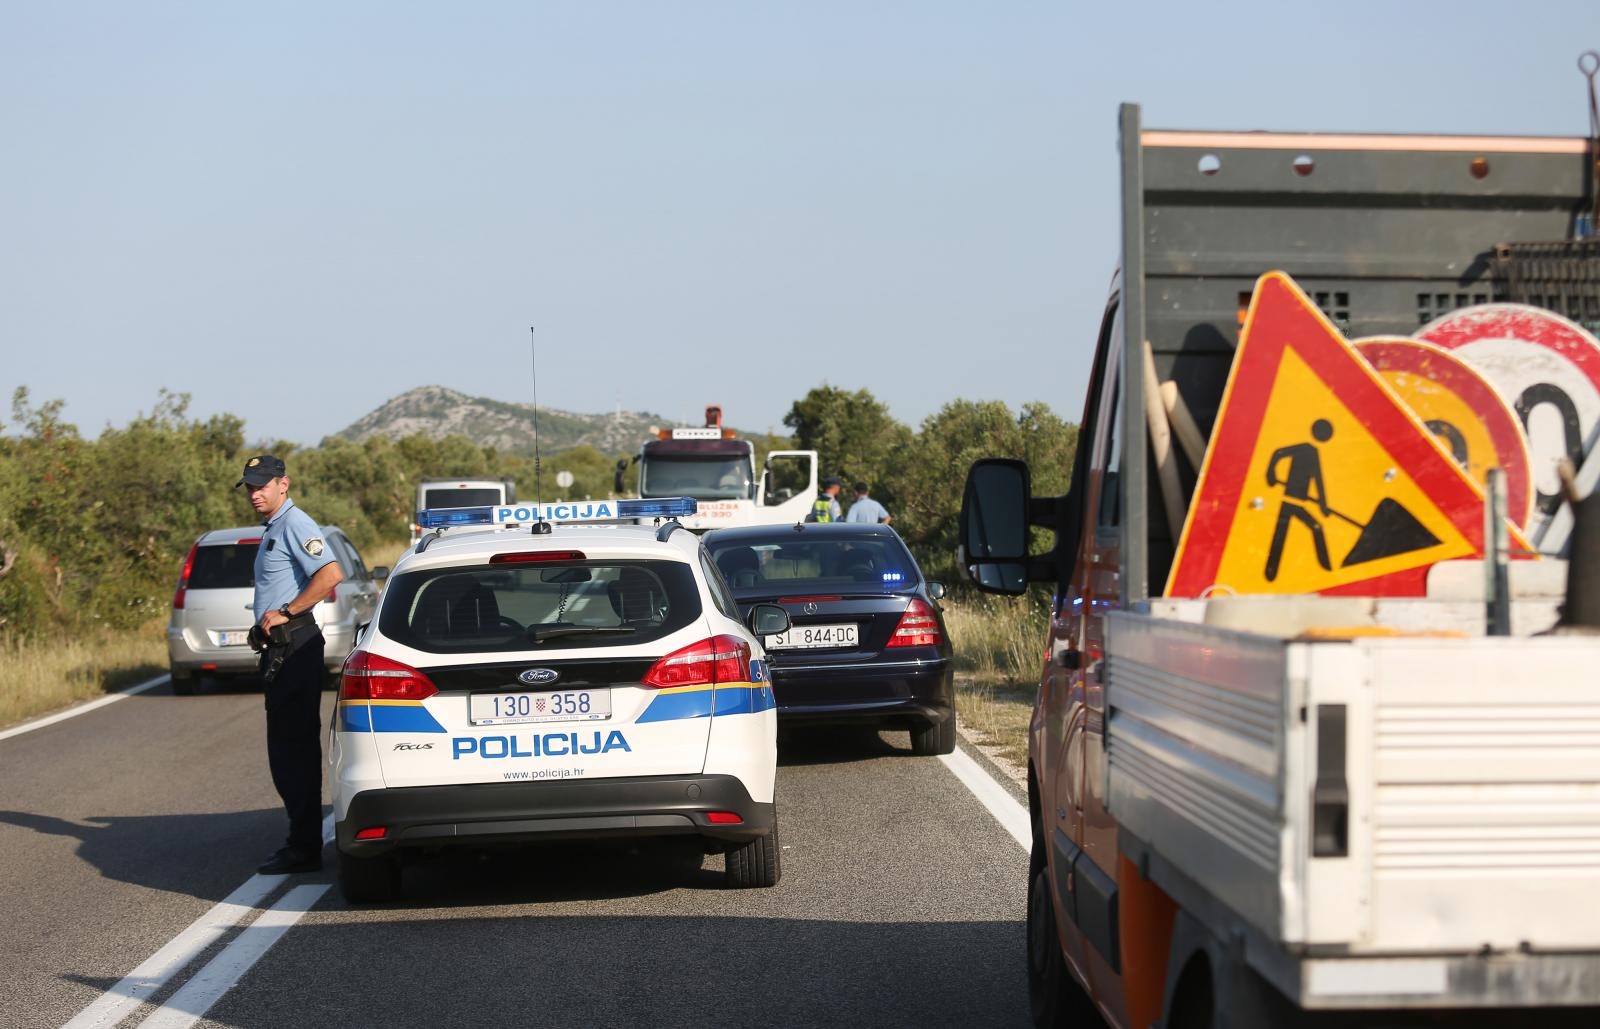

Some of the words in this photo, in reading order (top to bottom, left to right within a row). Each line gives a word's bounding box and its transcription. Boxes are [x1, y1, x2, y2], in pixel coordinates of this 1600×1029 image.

[499, 503, 612, 522] POLICIJA
[493, 695, 531, 717] 130
[551, 692, 591, 715] 358
[393, 742, 435, 752] FOCUS
[452, 730, 632, 760] POLICIJA
[503, 767, 585, 781] www.policija.hr
